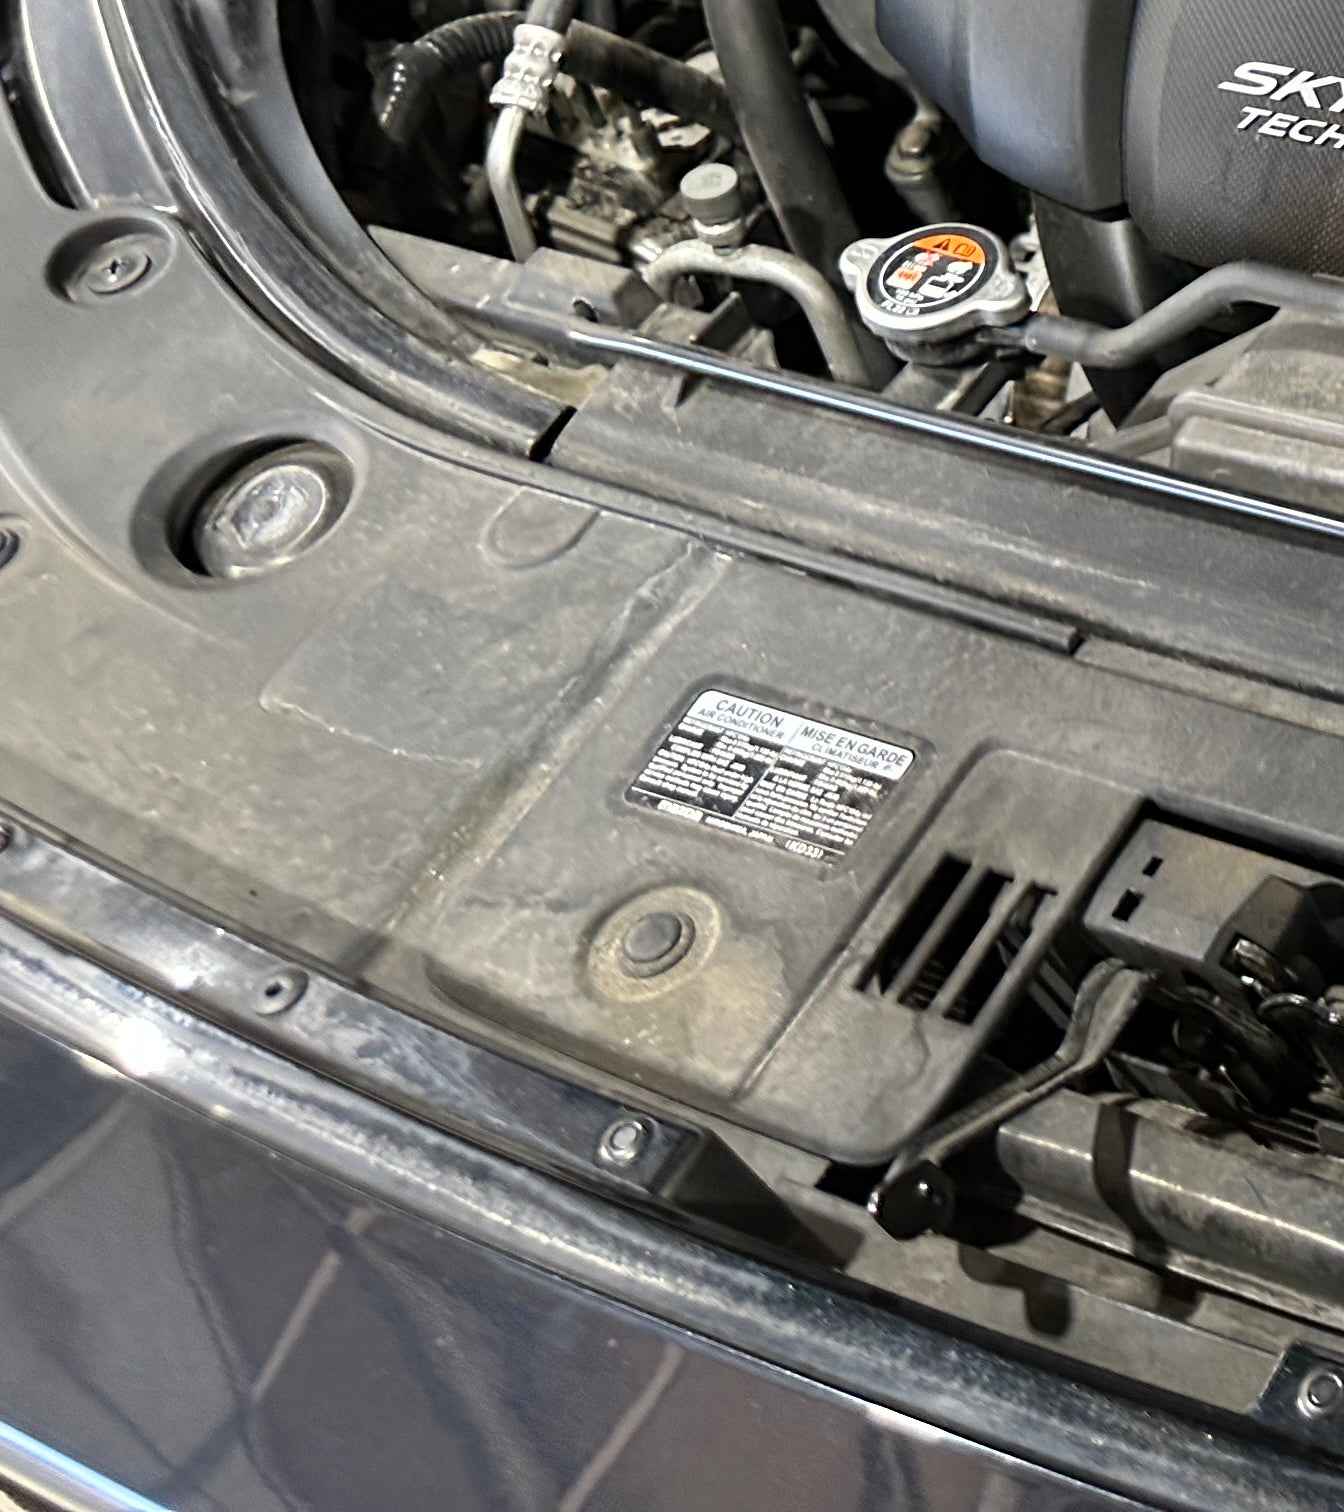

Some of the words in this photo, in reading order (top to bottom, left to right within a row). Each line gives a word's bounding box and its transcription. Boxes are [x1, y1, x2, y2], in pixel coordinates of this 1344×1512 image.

[715, 699, 784, 728] CAUTION
[716, 713, 785, 740] CONDITIONER
[800, 725, 835, 745] MISE
[836, 737, 858, 751] EN
[857, 742, 908, 767] GARDE
[811, 743, 879, 769] CLIMATISEUR
